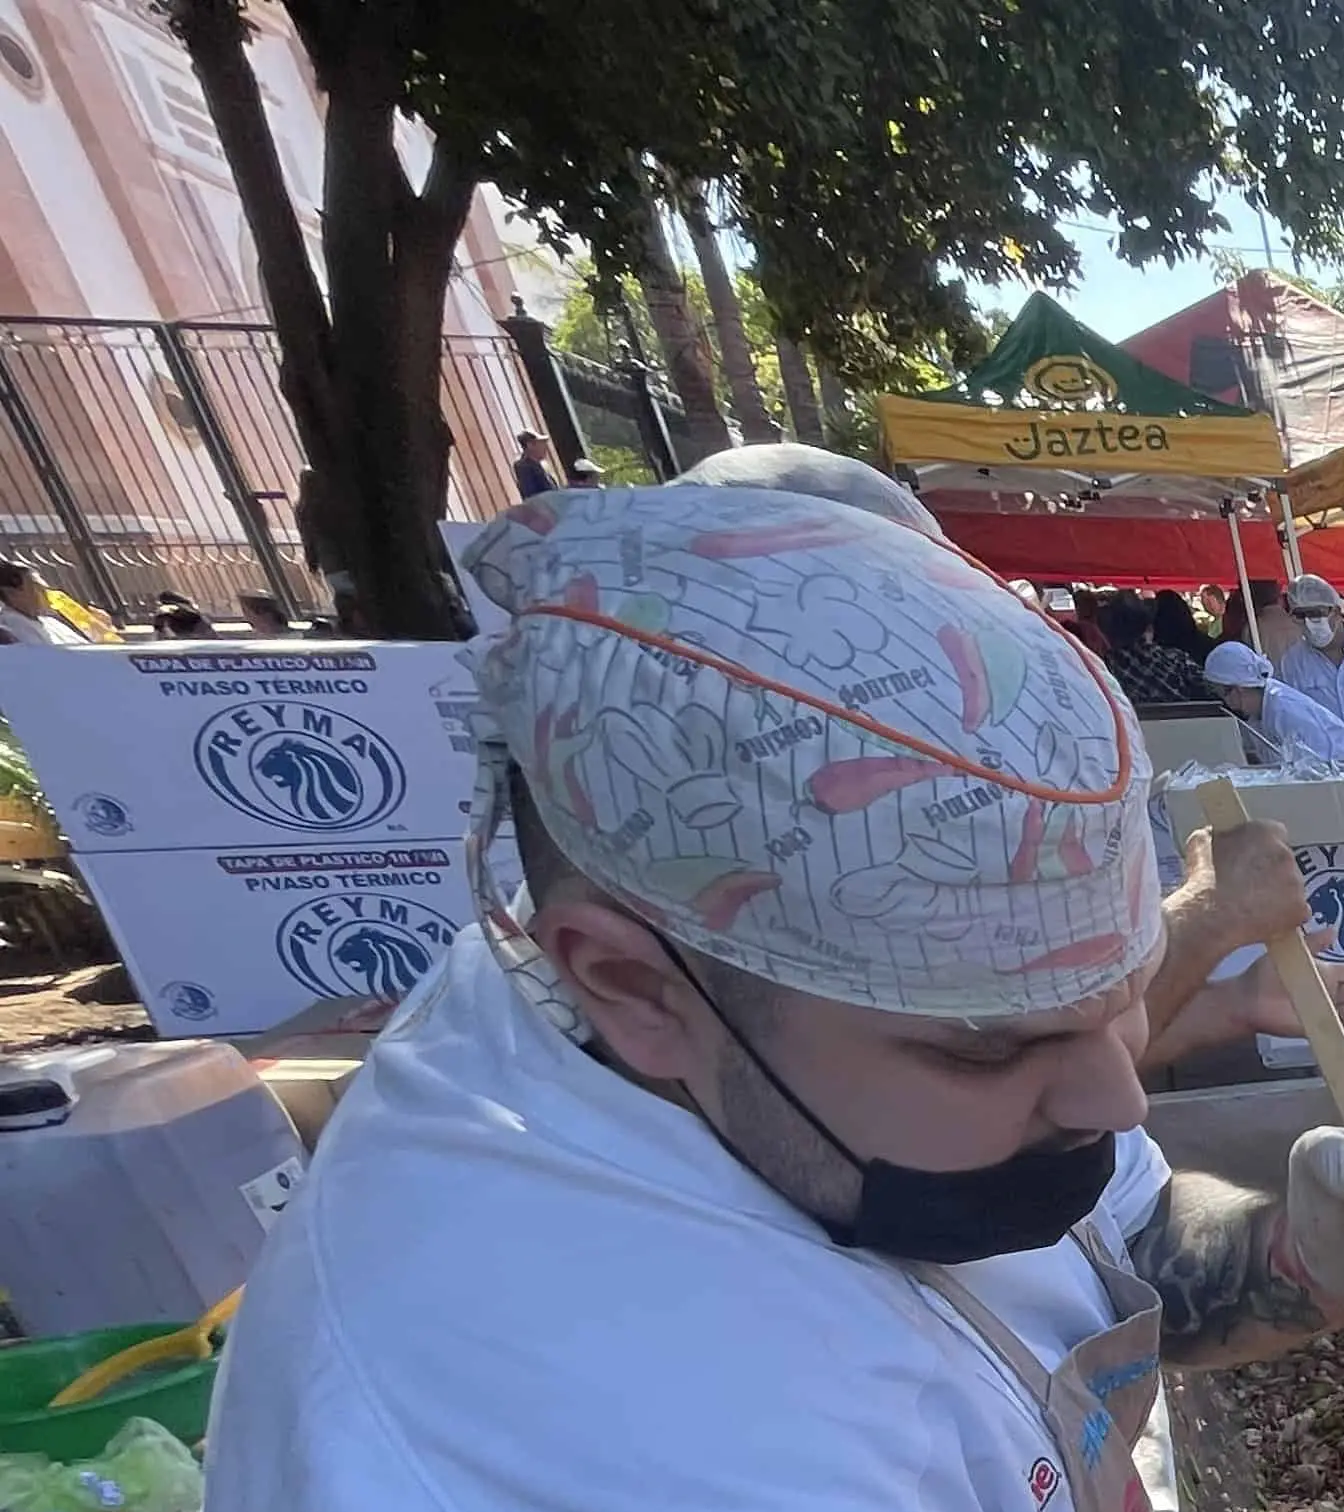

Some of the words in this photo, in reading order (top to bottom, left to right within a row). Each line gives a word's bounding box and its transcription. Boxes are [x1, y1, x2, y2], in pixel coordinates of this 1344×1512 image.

[1003, 420, 1169, 460] Jaztea
[210, 702, 371, 759] REYMA
[291, 896, 441, 947] REYMA
